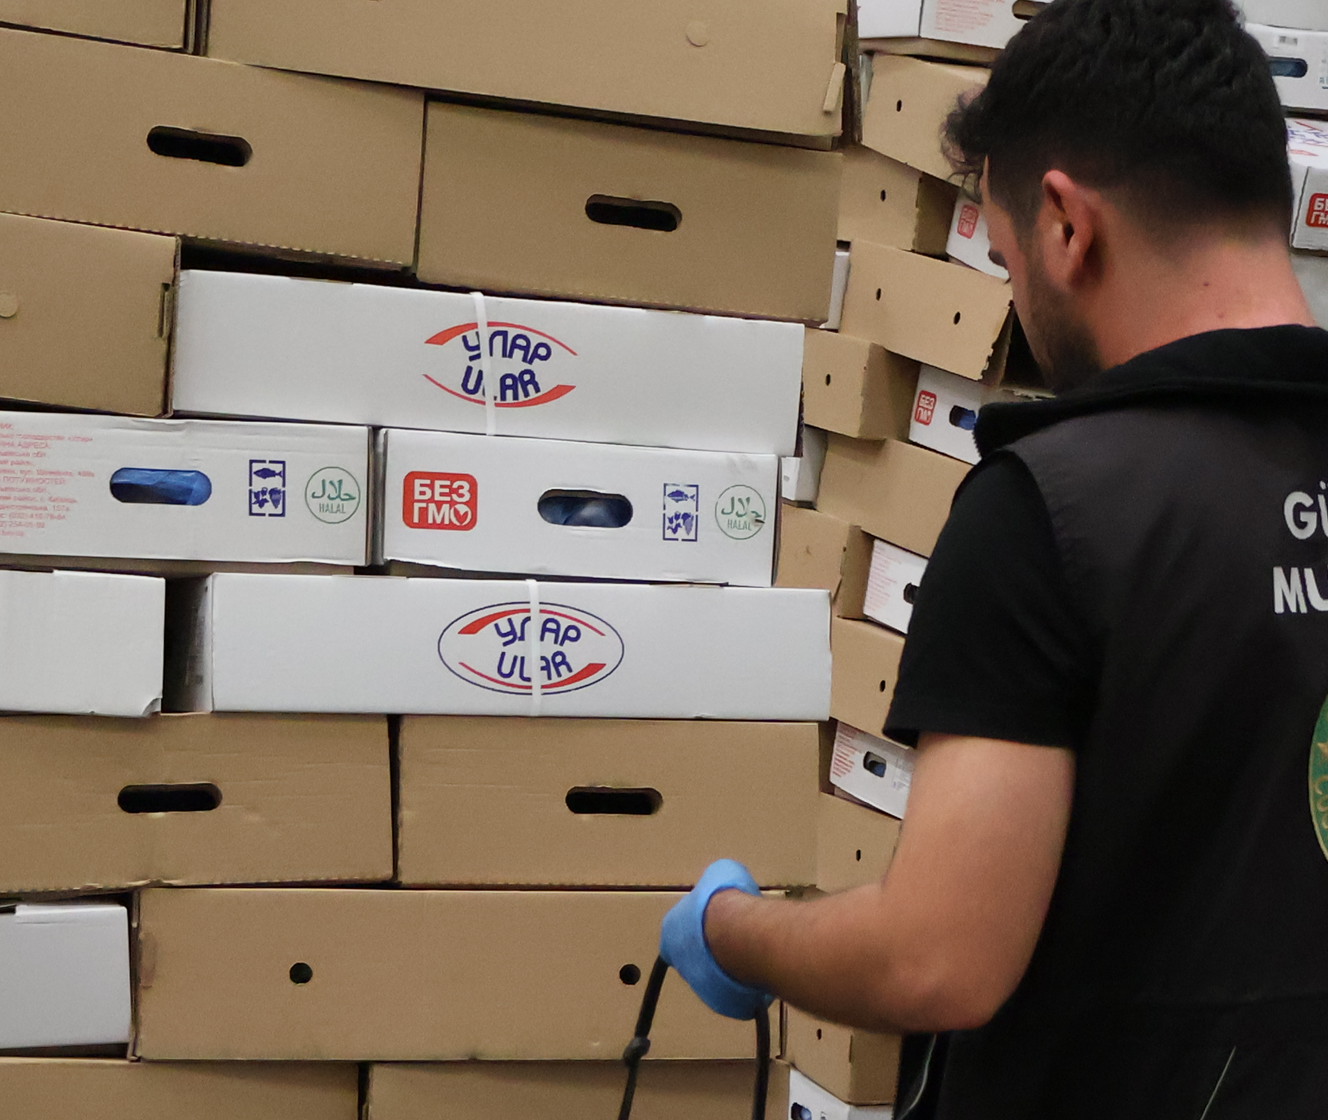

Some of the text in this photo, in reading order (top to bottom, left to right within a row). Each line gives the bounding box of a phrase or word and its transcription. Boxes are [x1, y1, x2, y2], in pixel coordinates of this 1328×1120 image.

[461, 365, 541, 401] UAR
[311, 478, 357, 502] حلال
[413, 478, 471, 503] БЕЗ
[319, 503, 347, 514] HALAL
[412, 502, 472, 526] ГМО
[727, 519, 753, 531] HALAL
